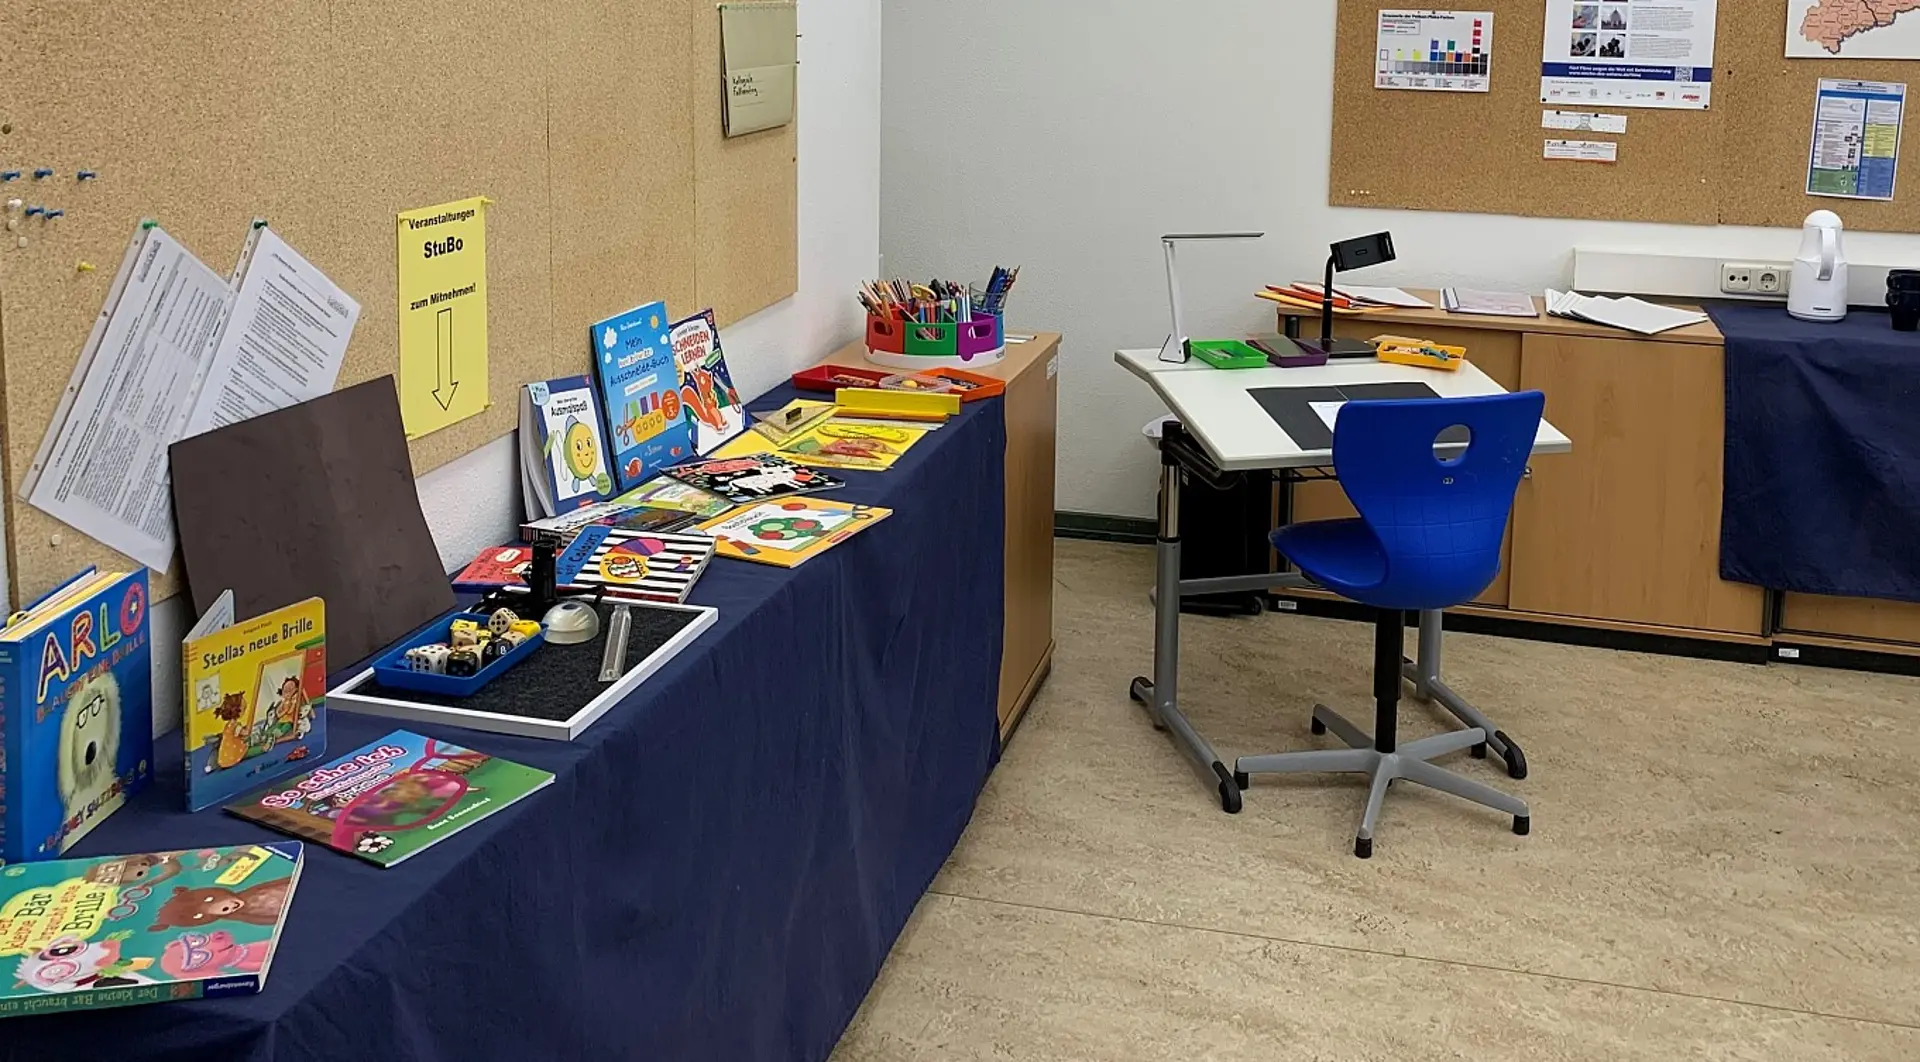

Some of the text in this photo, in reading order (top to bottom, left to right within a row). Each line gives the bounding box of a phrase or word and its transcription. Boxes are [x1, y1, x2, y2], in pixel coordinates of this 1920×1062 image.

[408, 208, 475, 230] Veranstaltungen
[423, 236, 464, 259] StuBo
[410, 282, 476, 311] zum Mitnehmen!
[624, 336, 643, 351] Mein
[36, 581, 146, 705] ARLO
[203, 645, 245, 670] Stellas
[248, 633, 279, 653] neue
[282, 616, 313, 641] Brille
[14, 892, 53, 919] Bär
[61, 891, 107, 933] Brille
[24, 996, 68, 1012] braucht
